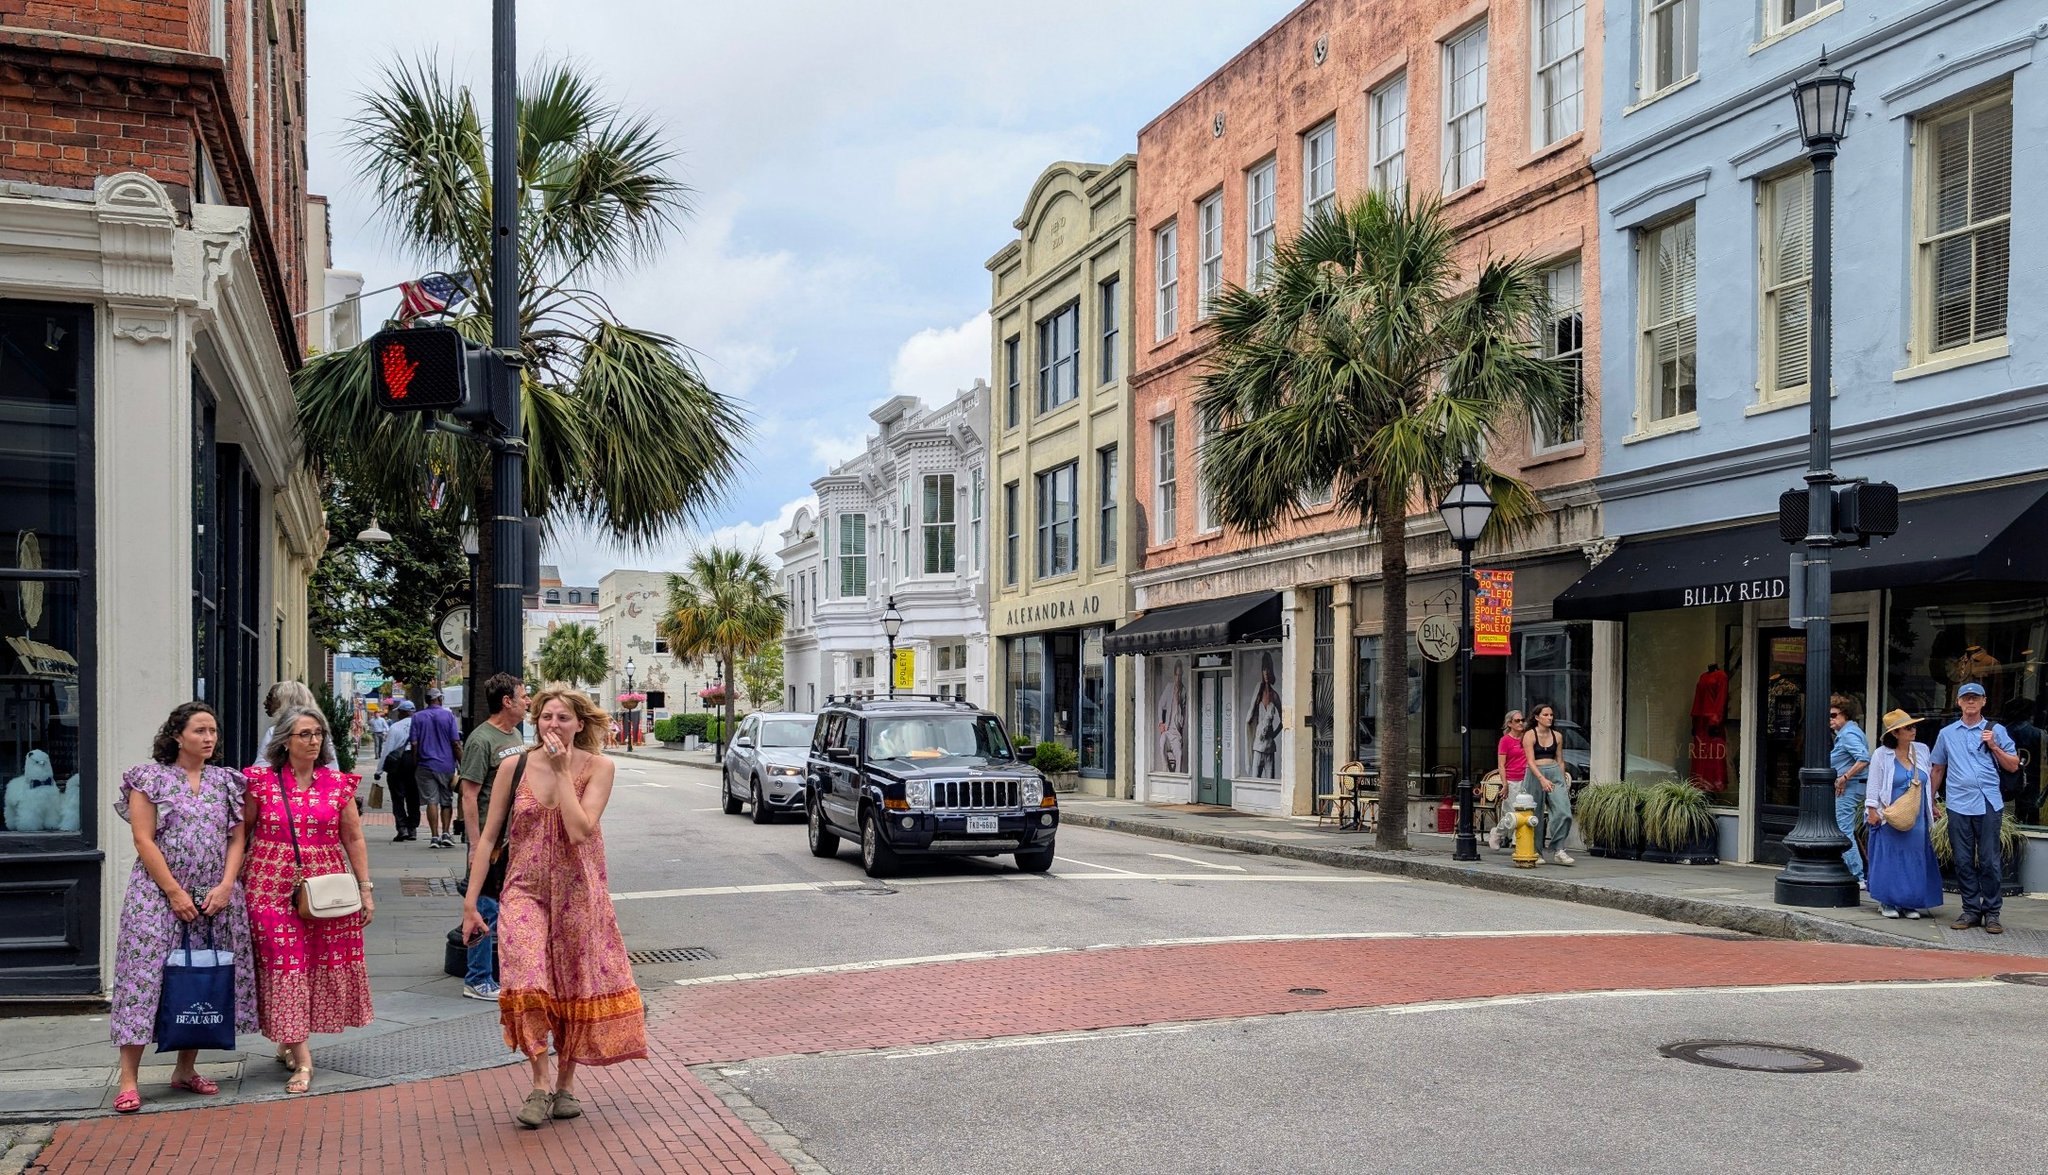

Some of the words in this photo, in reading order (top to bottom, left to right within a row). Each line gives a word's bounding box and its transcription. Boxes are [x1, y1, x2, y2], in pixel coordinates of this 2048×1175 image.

[1683, 584, 1734, 606] BILLY
[1738, 579, 1785, 601] REID
[1006, 600, 1075, 625] ALEXANDRA
[1082, 595, 1100, 614] AD
[1423, 623, 1446, 638] BIN
[1475, 623, 1511, 632] SPOLETO
[899, 652, 907, 686] SPOLETO
[1688, 742, 1727, 760] REID
[176, 1014, 224, 1024] BEAU&RO
